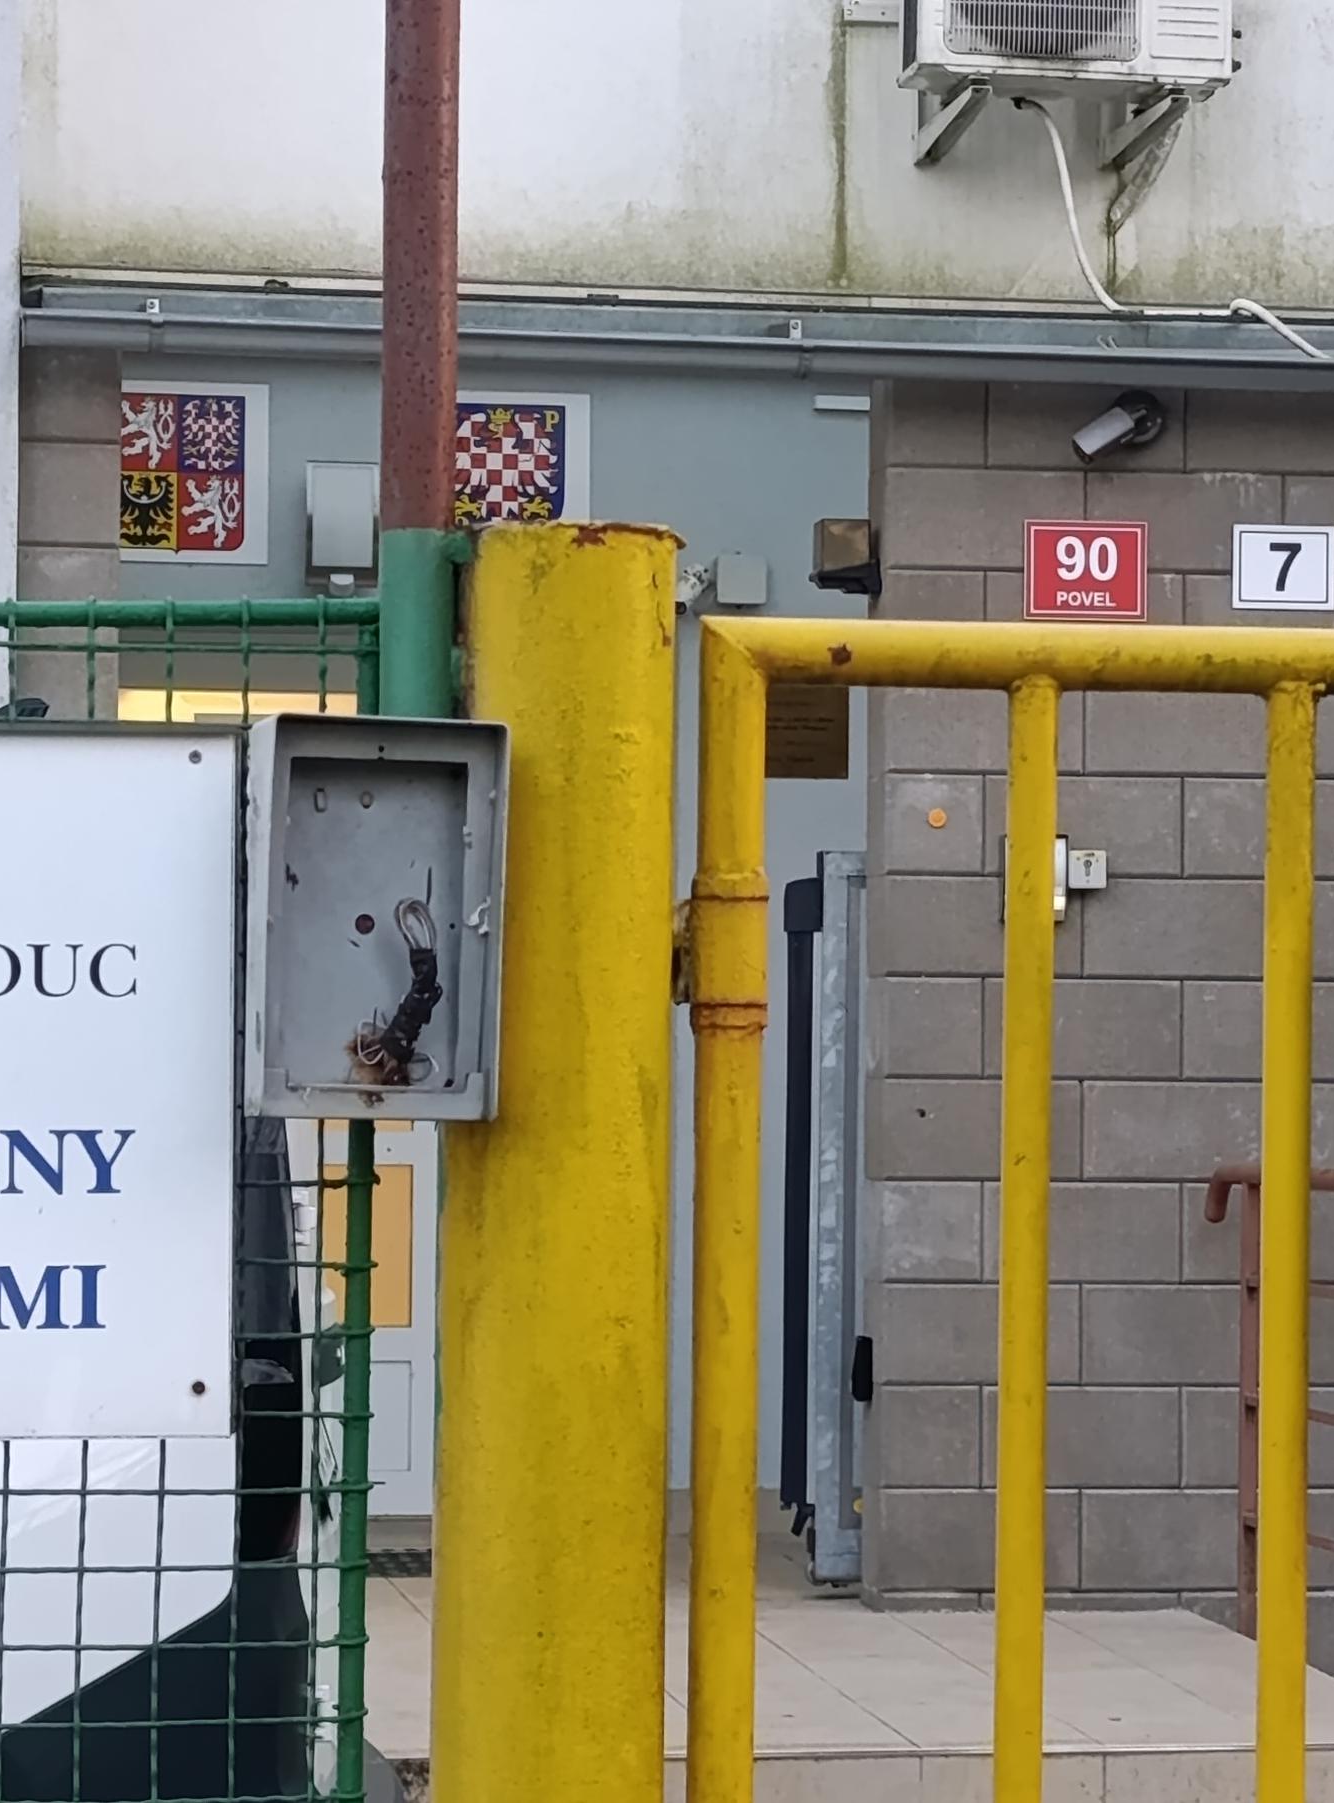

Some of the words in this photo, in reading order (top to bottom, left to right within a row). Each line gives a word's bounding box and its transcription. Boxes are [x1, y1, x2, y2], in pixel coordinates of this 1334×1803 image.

[543, 410, 560, 433] P
[1055, 535, 1118, 581] 90
[1269, 542, 1302, 592] 7
[1056, 590, 1117, 607] POVEL
